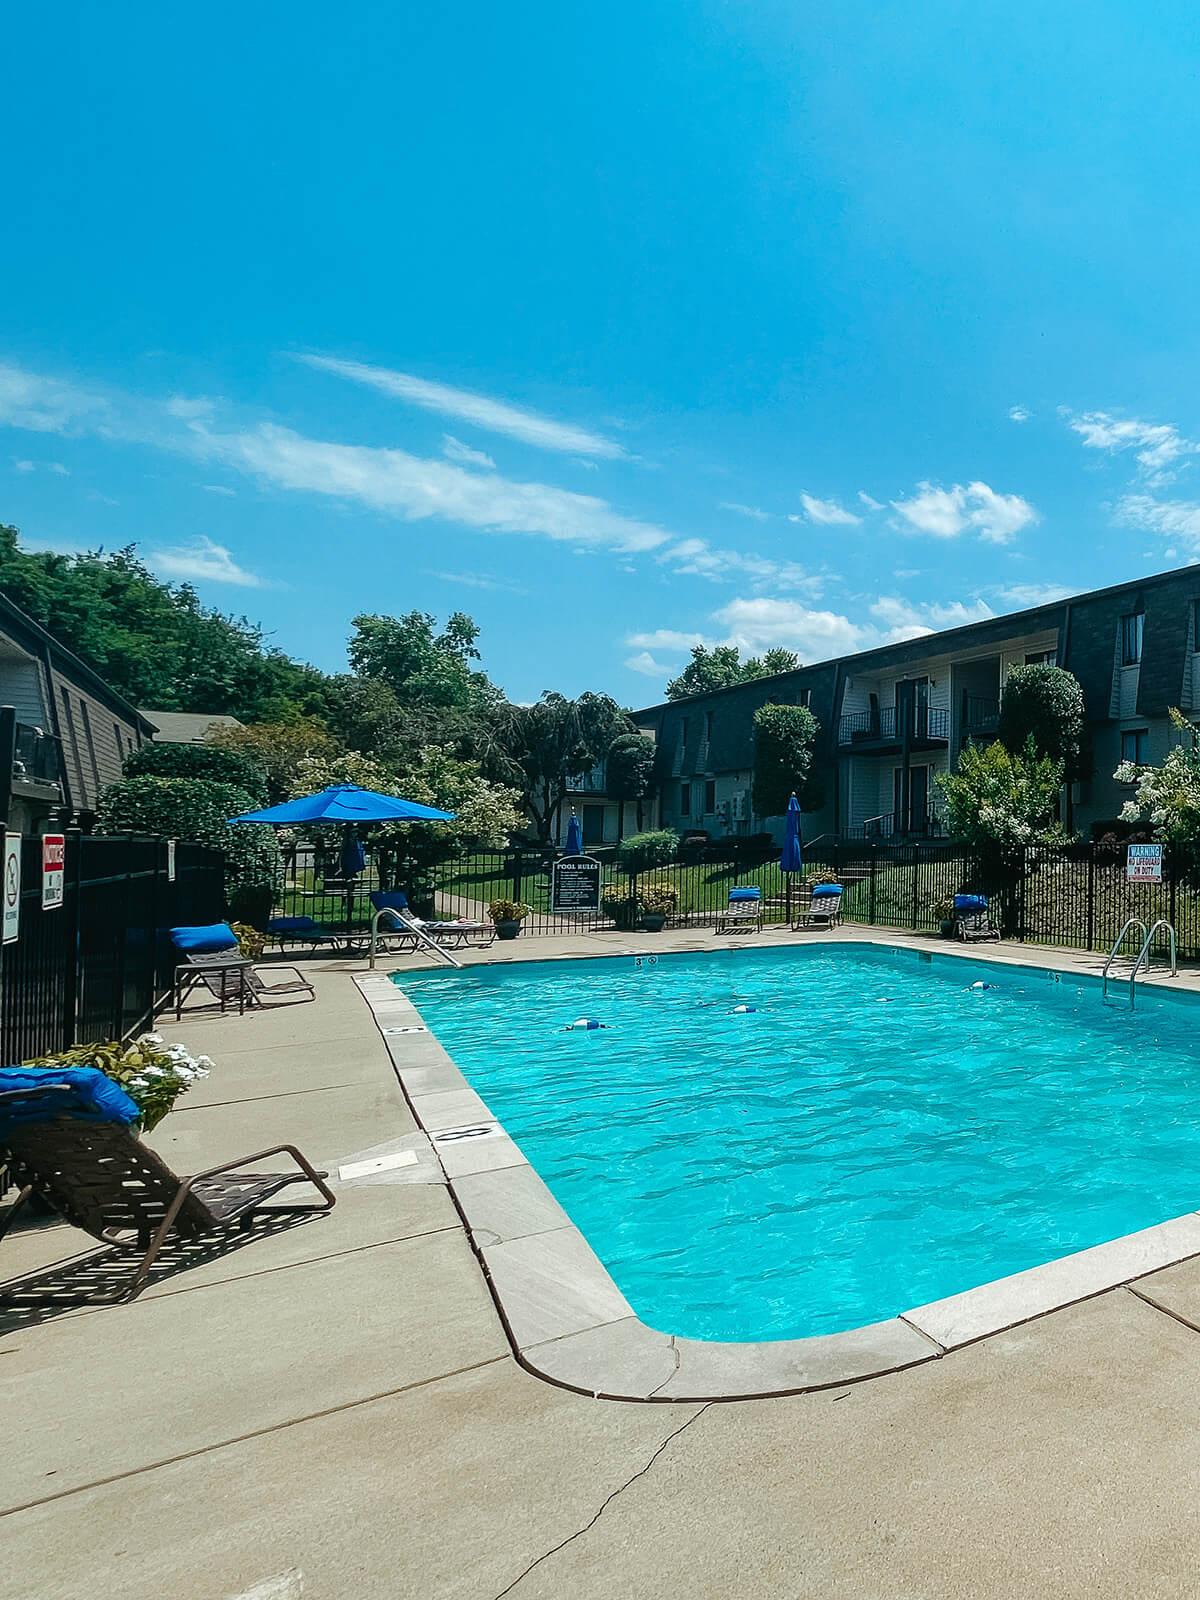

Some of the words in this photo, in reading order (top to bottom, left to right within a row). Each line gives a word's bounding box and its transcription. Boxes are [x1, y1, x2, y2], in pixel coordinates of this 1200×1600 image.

[1131, 847, 1159, 857] WARNING
[1136, 857, 1160, 866] LIFEGUARD
[1142, 866, 1154, 875] DUTY
